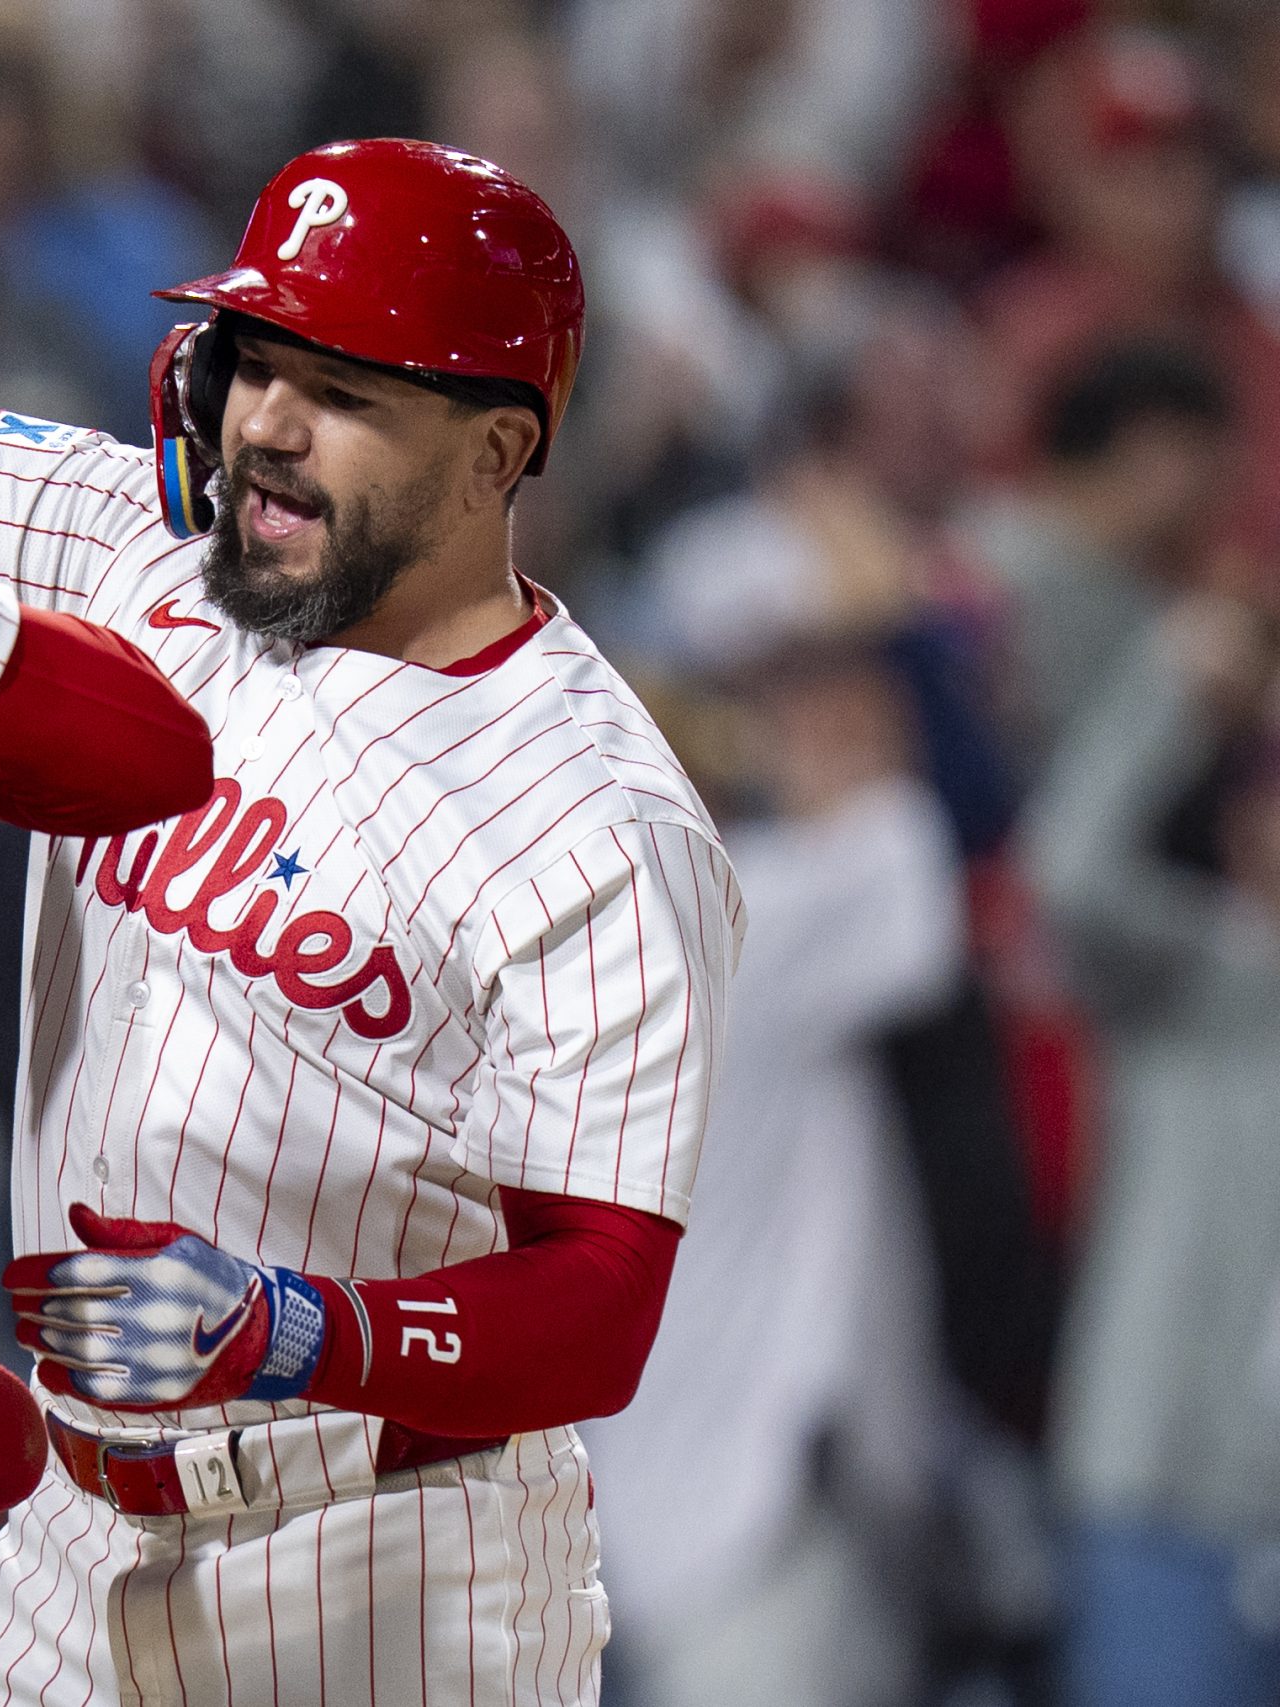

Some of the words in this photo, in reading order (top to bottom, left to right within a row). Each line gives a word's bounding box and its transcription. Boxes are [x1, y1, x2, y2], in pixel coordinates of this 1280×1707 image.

[277, 177, 348, 261] P
[49, 776, 412, 1039] illies
[396, 1296, 462, 1365] 12
[185, 1456, 234, 1506] 12
